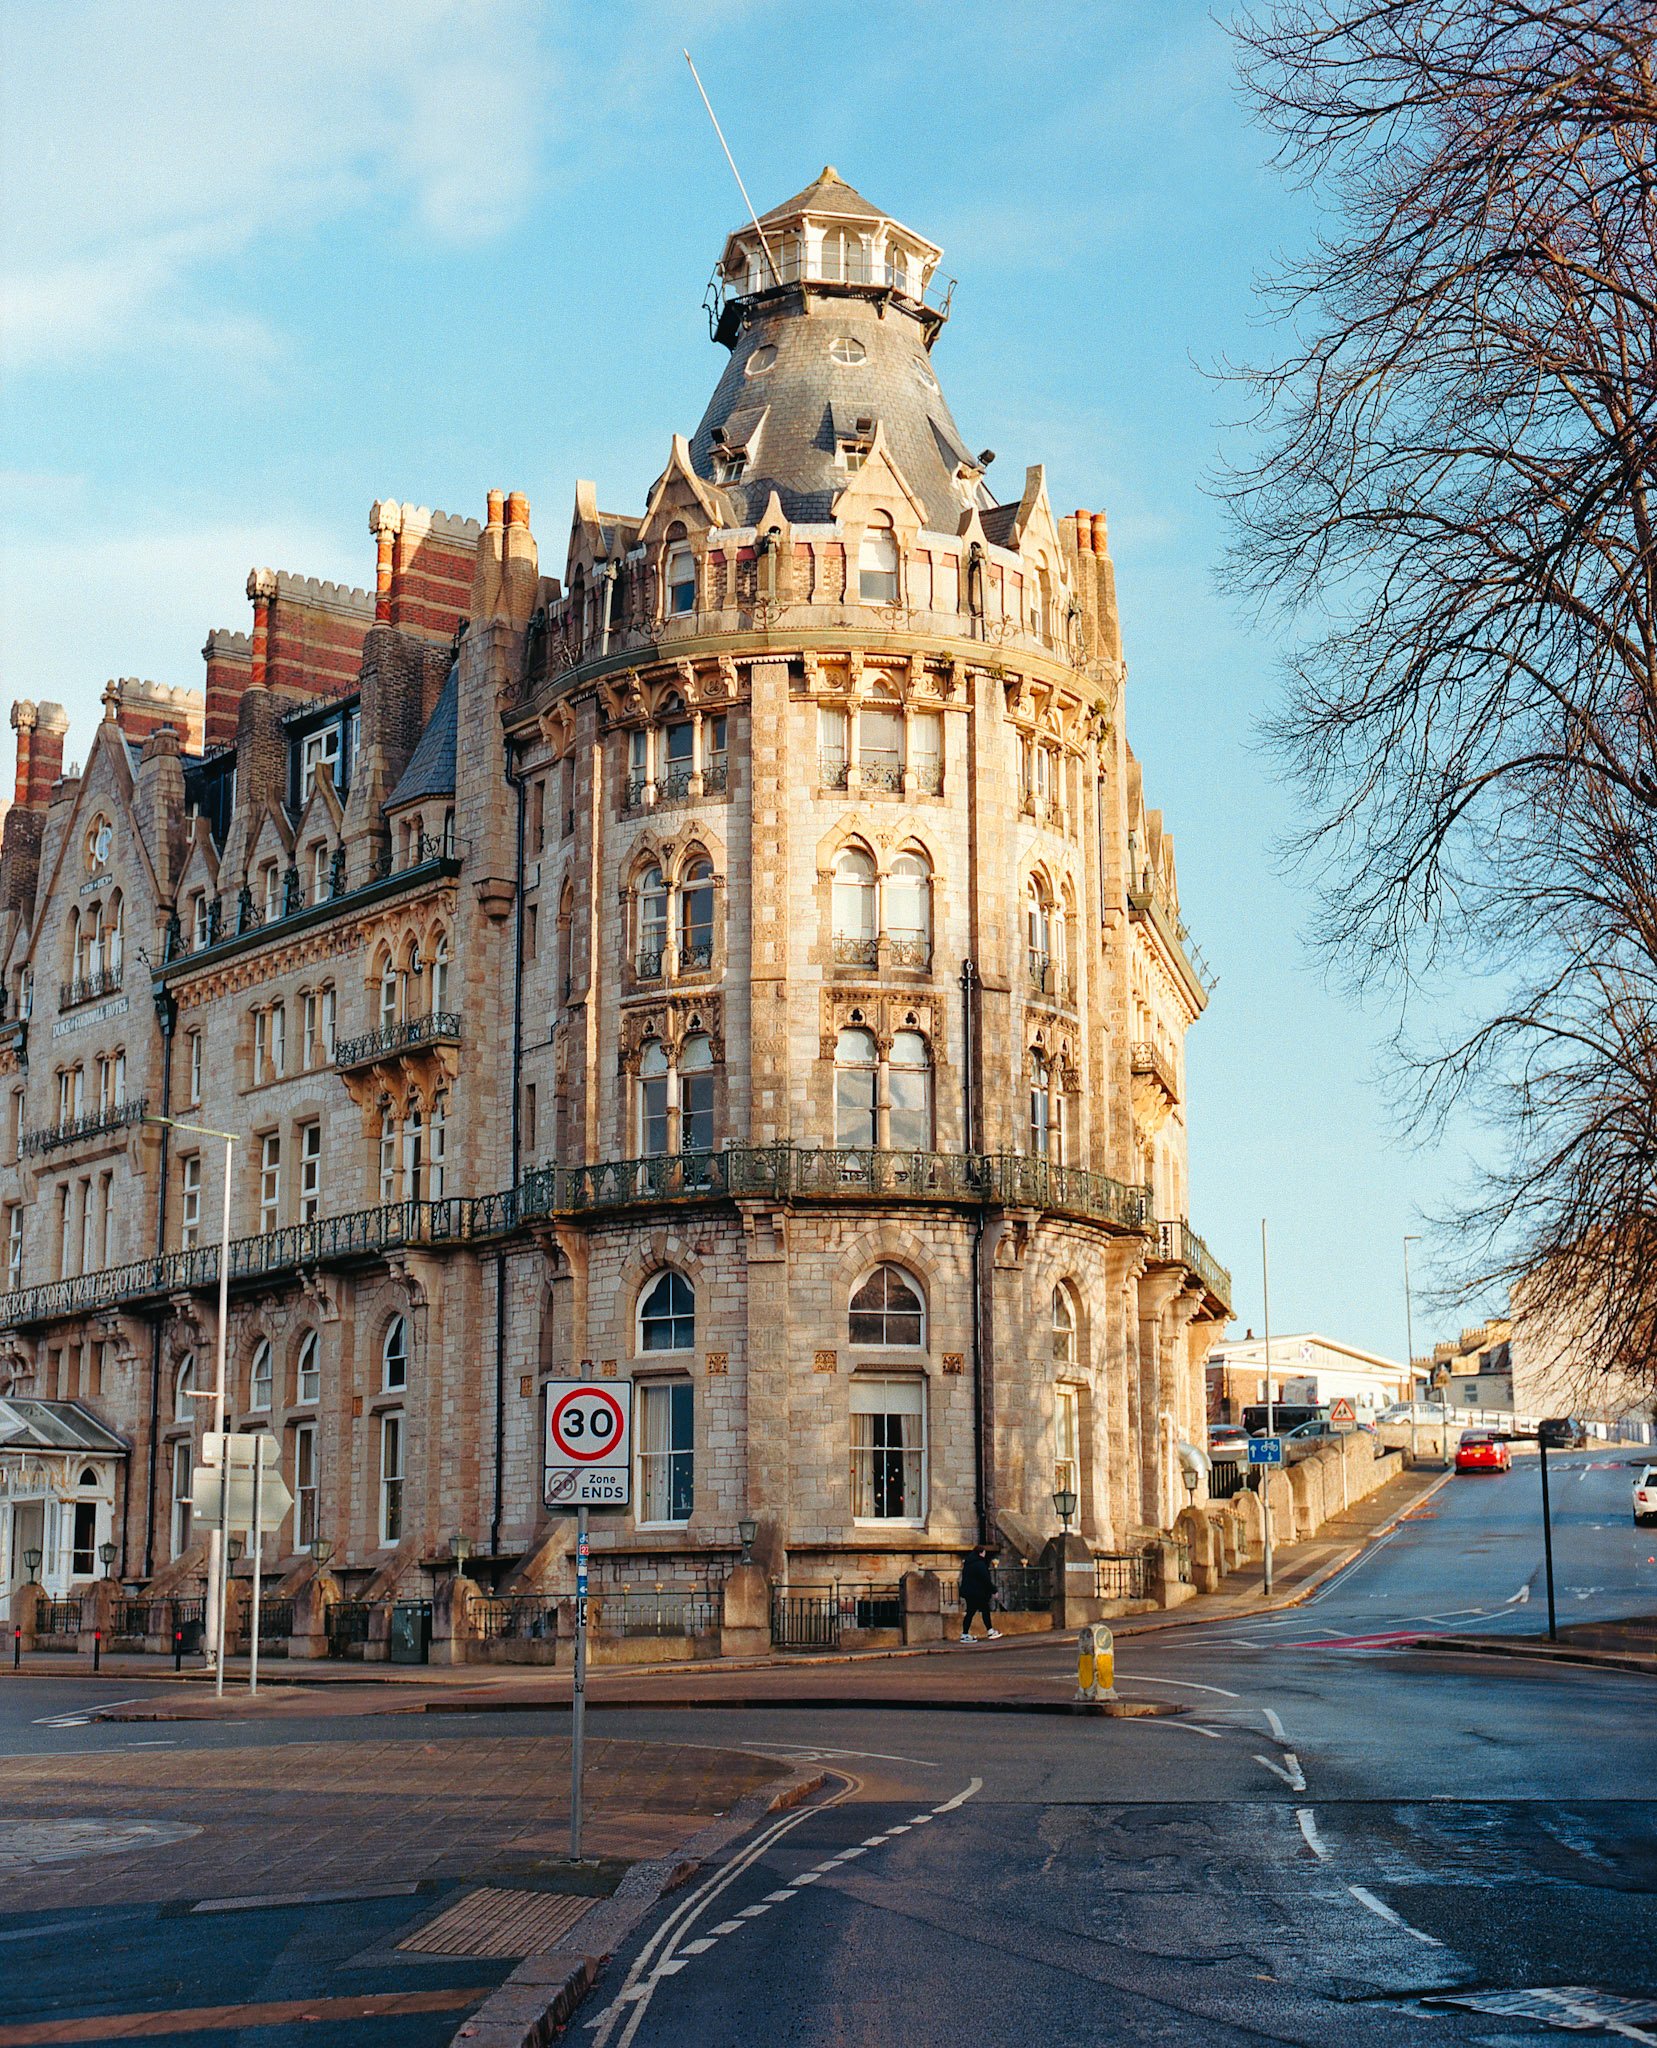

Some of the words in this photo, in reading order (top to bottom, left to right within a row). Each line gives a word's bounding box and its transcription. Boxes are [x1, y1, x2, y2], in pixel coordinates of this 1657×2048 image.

[52, 1019, 70, 1038] DUKE
[106, 998, 128, 1018] HOTEL
[0, 1294, 20, 1317] KE
[20, 1289, 36, 1314] OF
[38, 1274, 106, 1309] CORNWALL
[109, 1263, 152, 1294] HOTEL
[563, 1408, 613, 1438] 30
[553, 1479, 573, 1491] 20
[589, 1474, 616, 1484] Zone
[582, 1487, 624, 1498] ENDS
